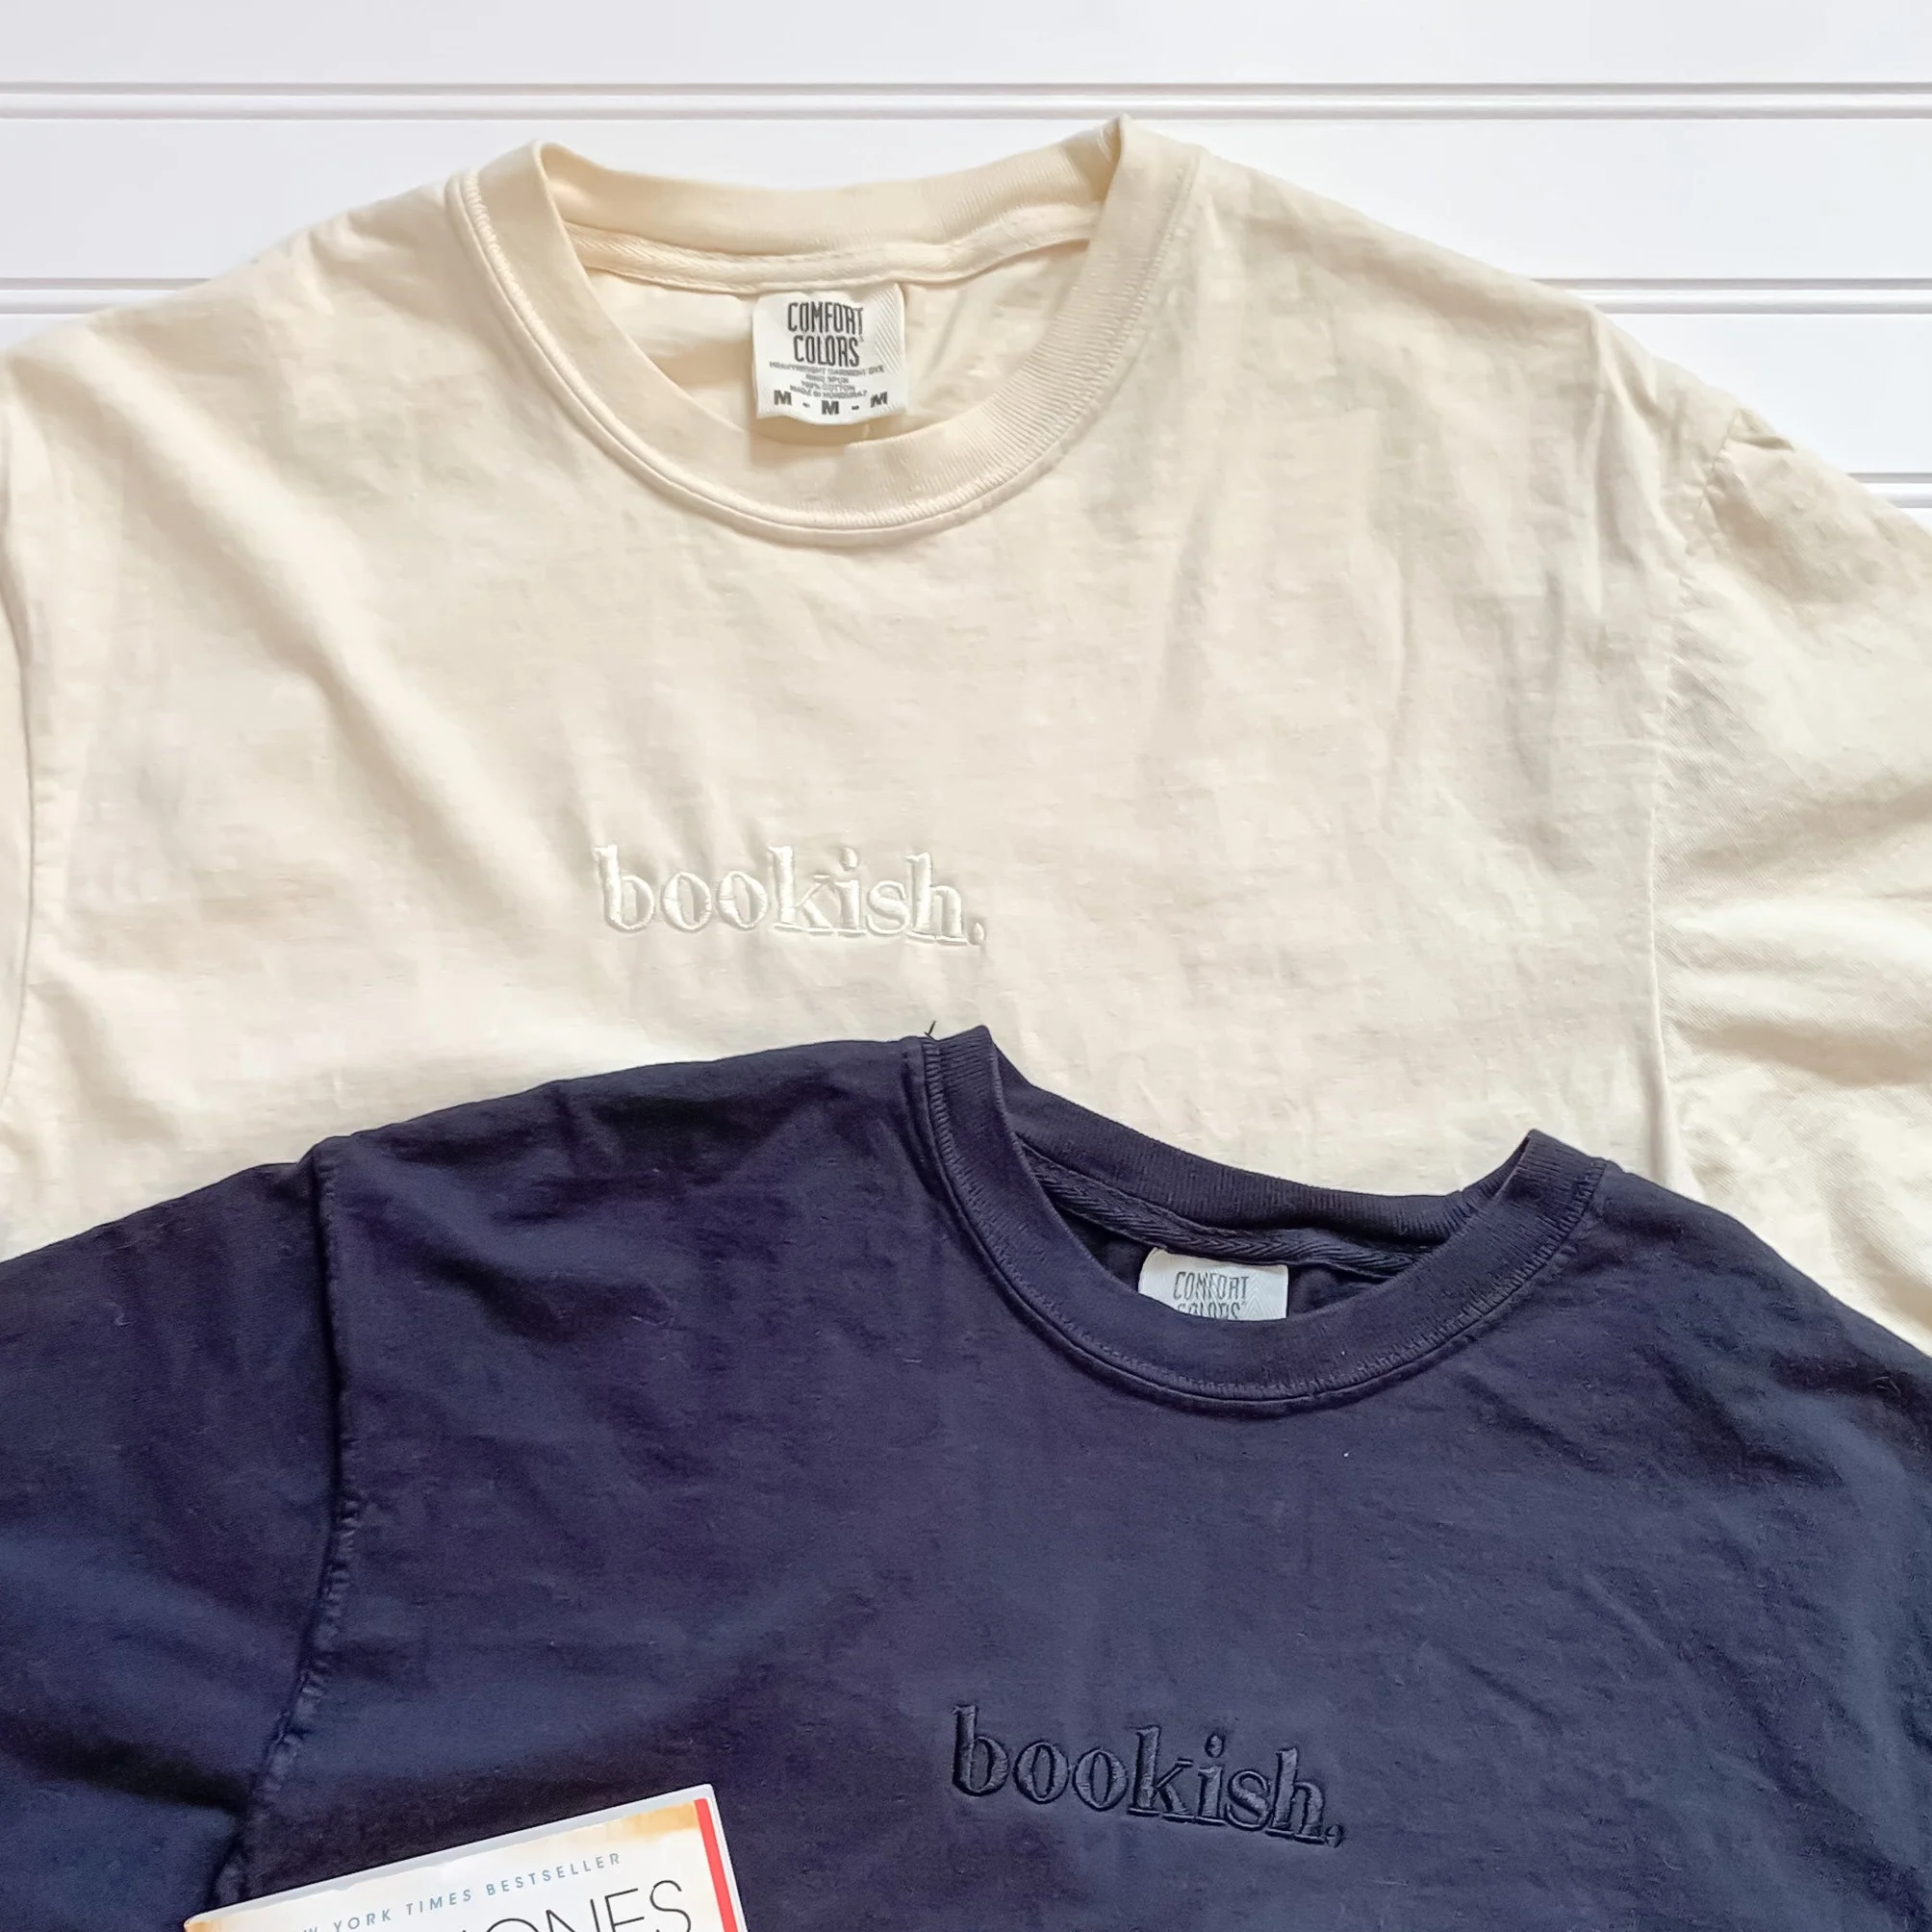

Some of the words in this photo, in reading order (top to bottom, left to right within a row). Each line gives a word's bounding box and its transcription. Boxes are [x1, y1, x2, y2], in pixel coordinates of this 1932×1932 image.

[787, 300, 864, 335] COMFORT
[793, 335, 860, 367] COLORS
[774, 390, 792, 405] M
[822, 400, 839, 415] M
[870, 392, 888, 408] M
[593, 844, 986, 946] bookish.
[1178, 1301, 1241, 1319] LORS
[951, 1703, 1346, 1848] bookish.
[333, 1908, 392, 1932] YORK
[406, 1889, 472, 1916] TIMES
[486, 1852, 621, 1895] BESTSELLER
